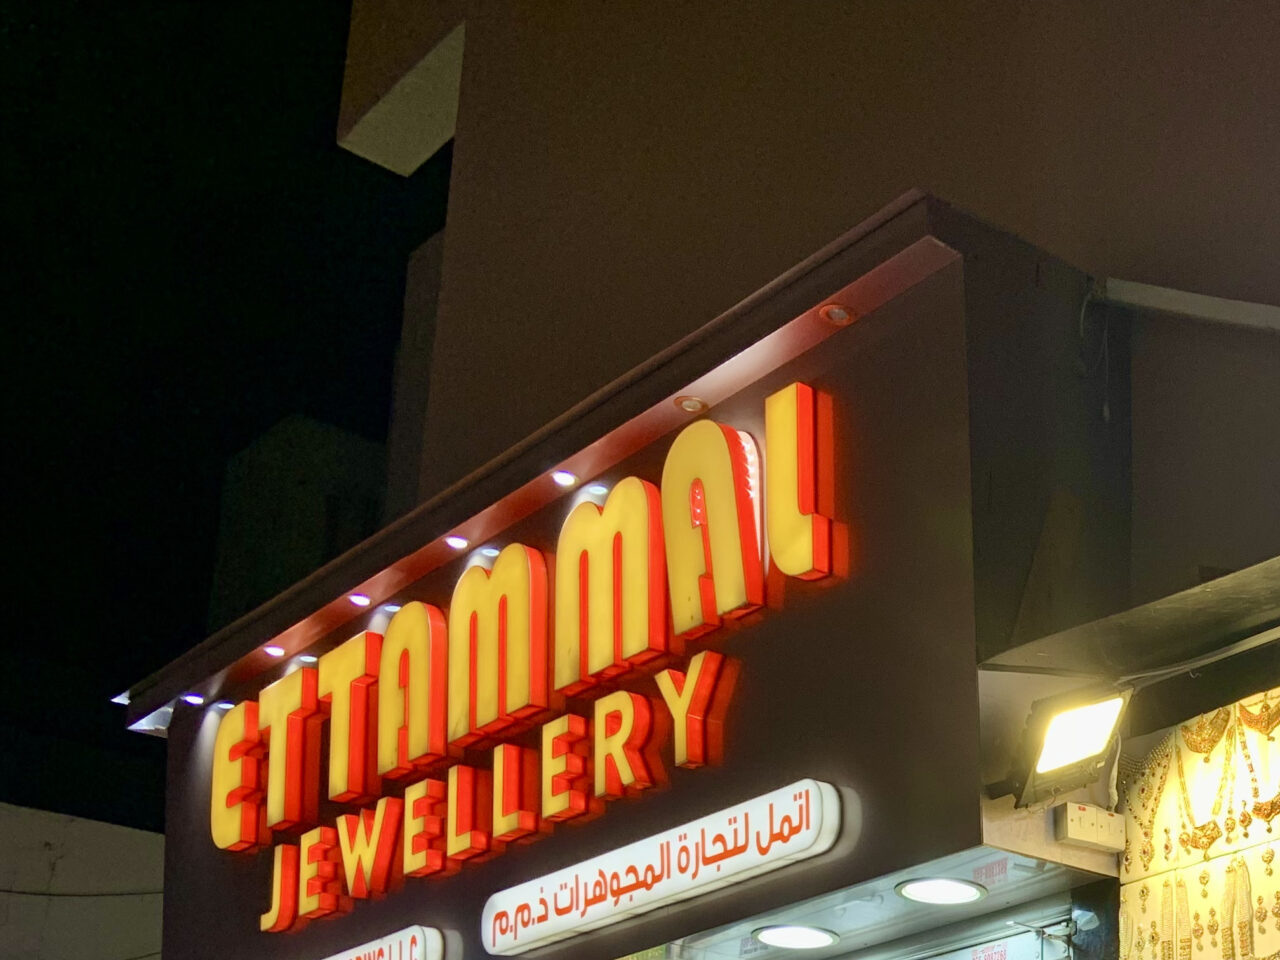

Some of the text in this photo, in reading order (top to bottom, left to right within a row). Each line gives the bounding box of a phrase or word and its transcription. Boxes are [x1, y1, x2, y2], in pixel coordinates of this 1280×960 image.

[210, 381, 832, 853] ETTAMMAL
[259, 650, 726, 932] JEWELLERY
[755, 788, 811, 857] اتمل
[553, 839, 672, 919] المجوهرات
[676, 812, 751, 881] لتجارة
